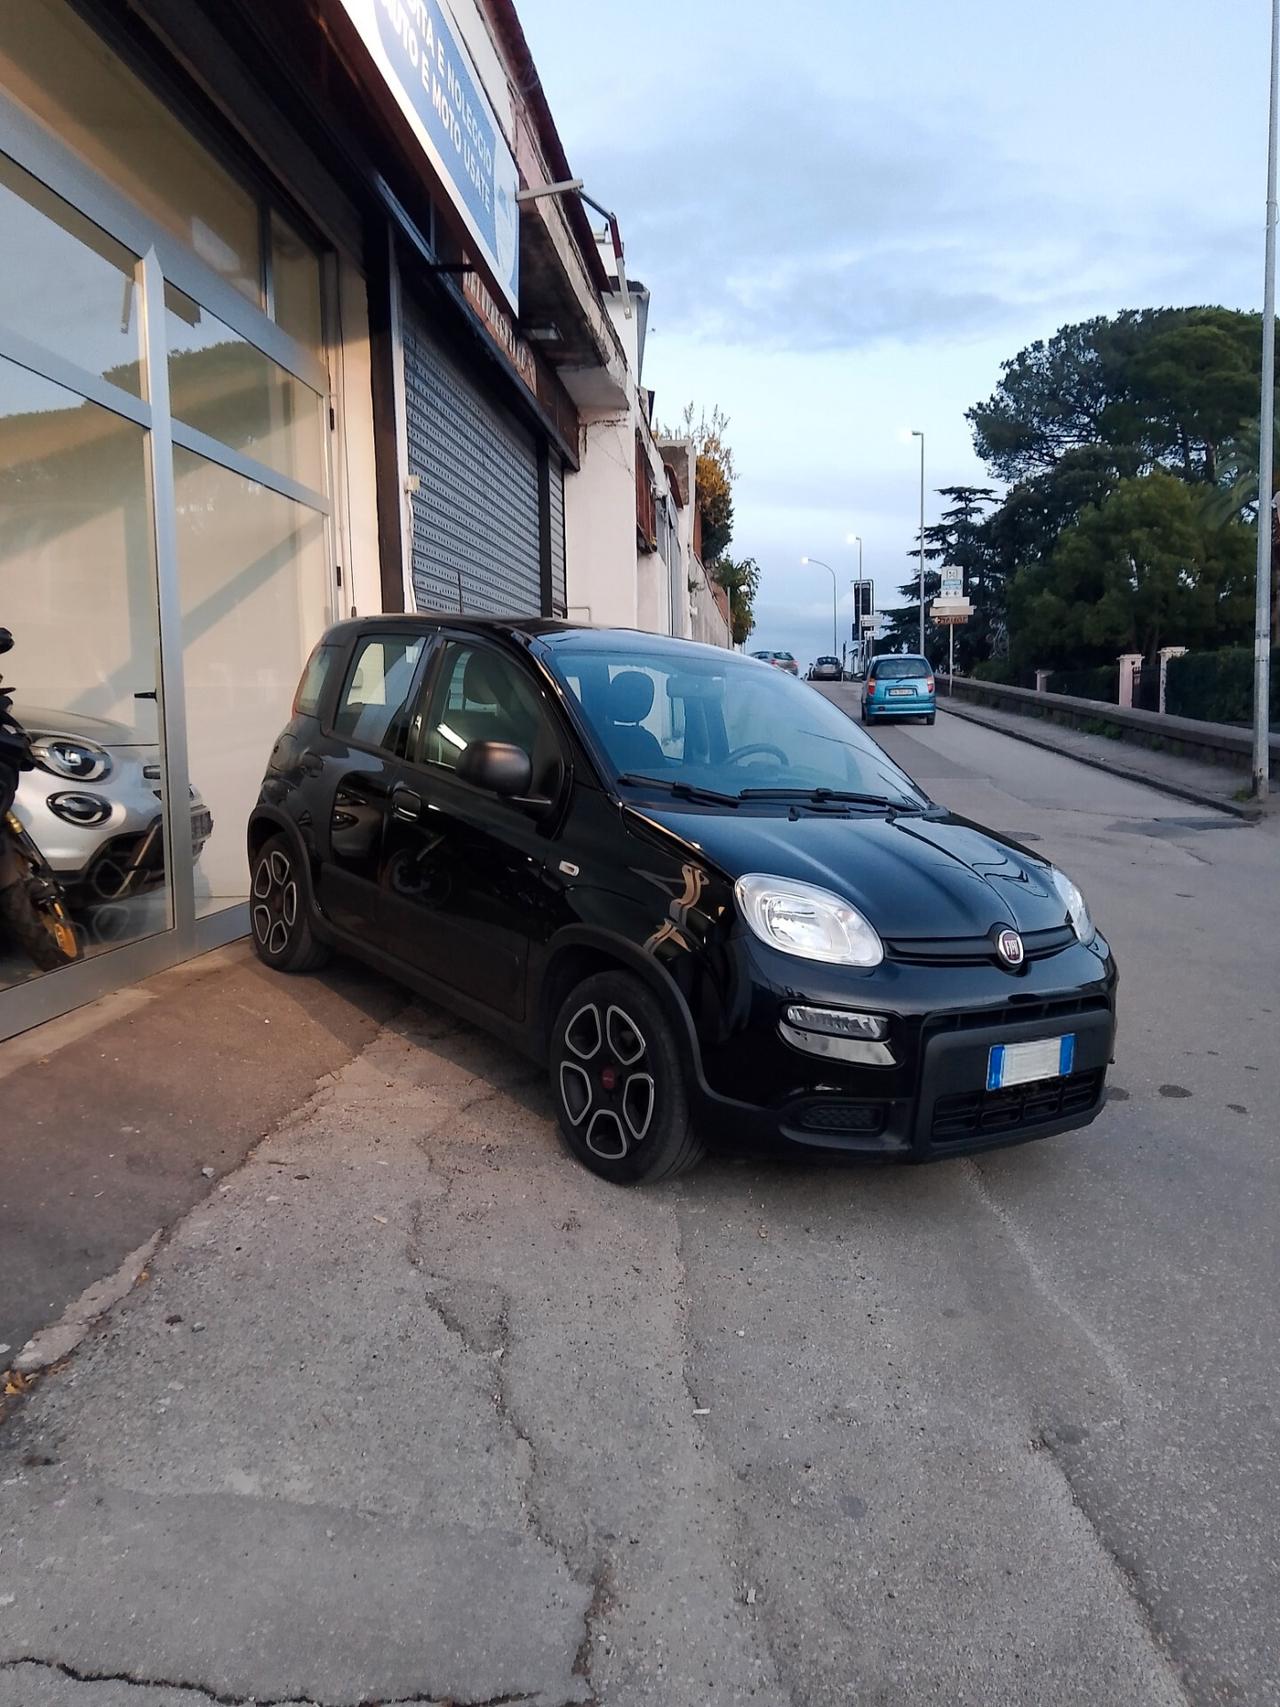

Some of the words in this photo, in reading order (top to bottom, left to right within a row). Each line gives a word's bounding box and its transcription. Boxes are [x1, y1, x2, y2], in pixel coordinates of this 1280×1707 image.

[421, 50, 430, 93] E
[432, 72, 462, 153] MOTO
[463, 142, 491, 214] USATE
[437, 36, 445, 78] E
[447, 62, 493, 175] NOLEGGIO
[1004, 940, 1019, 956] FIAT
